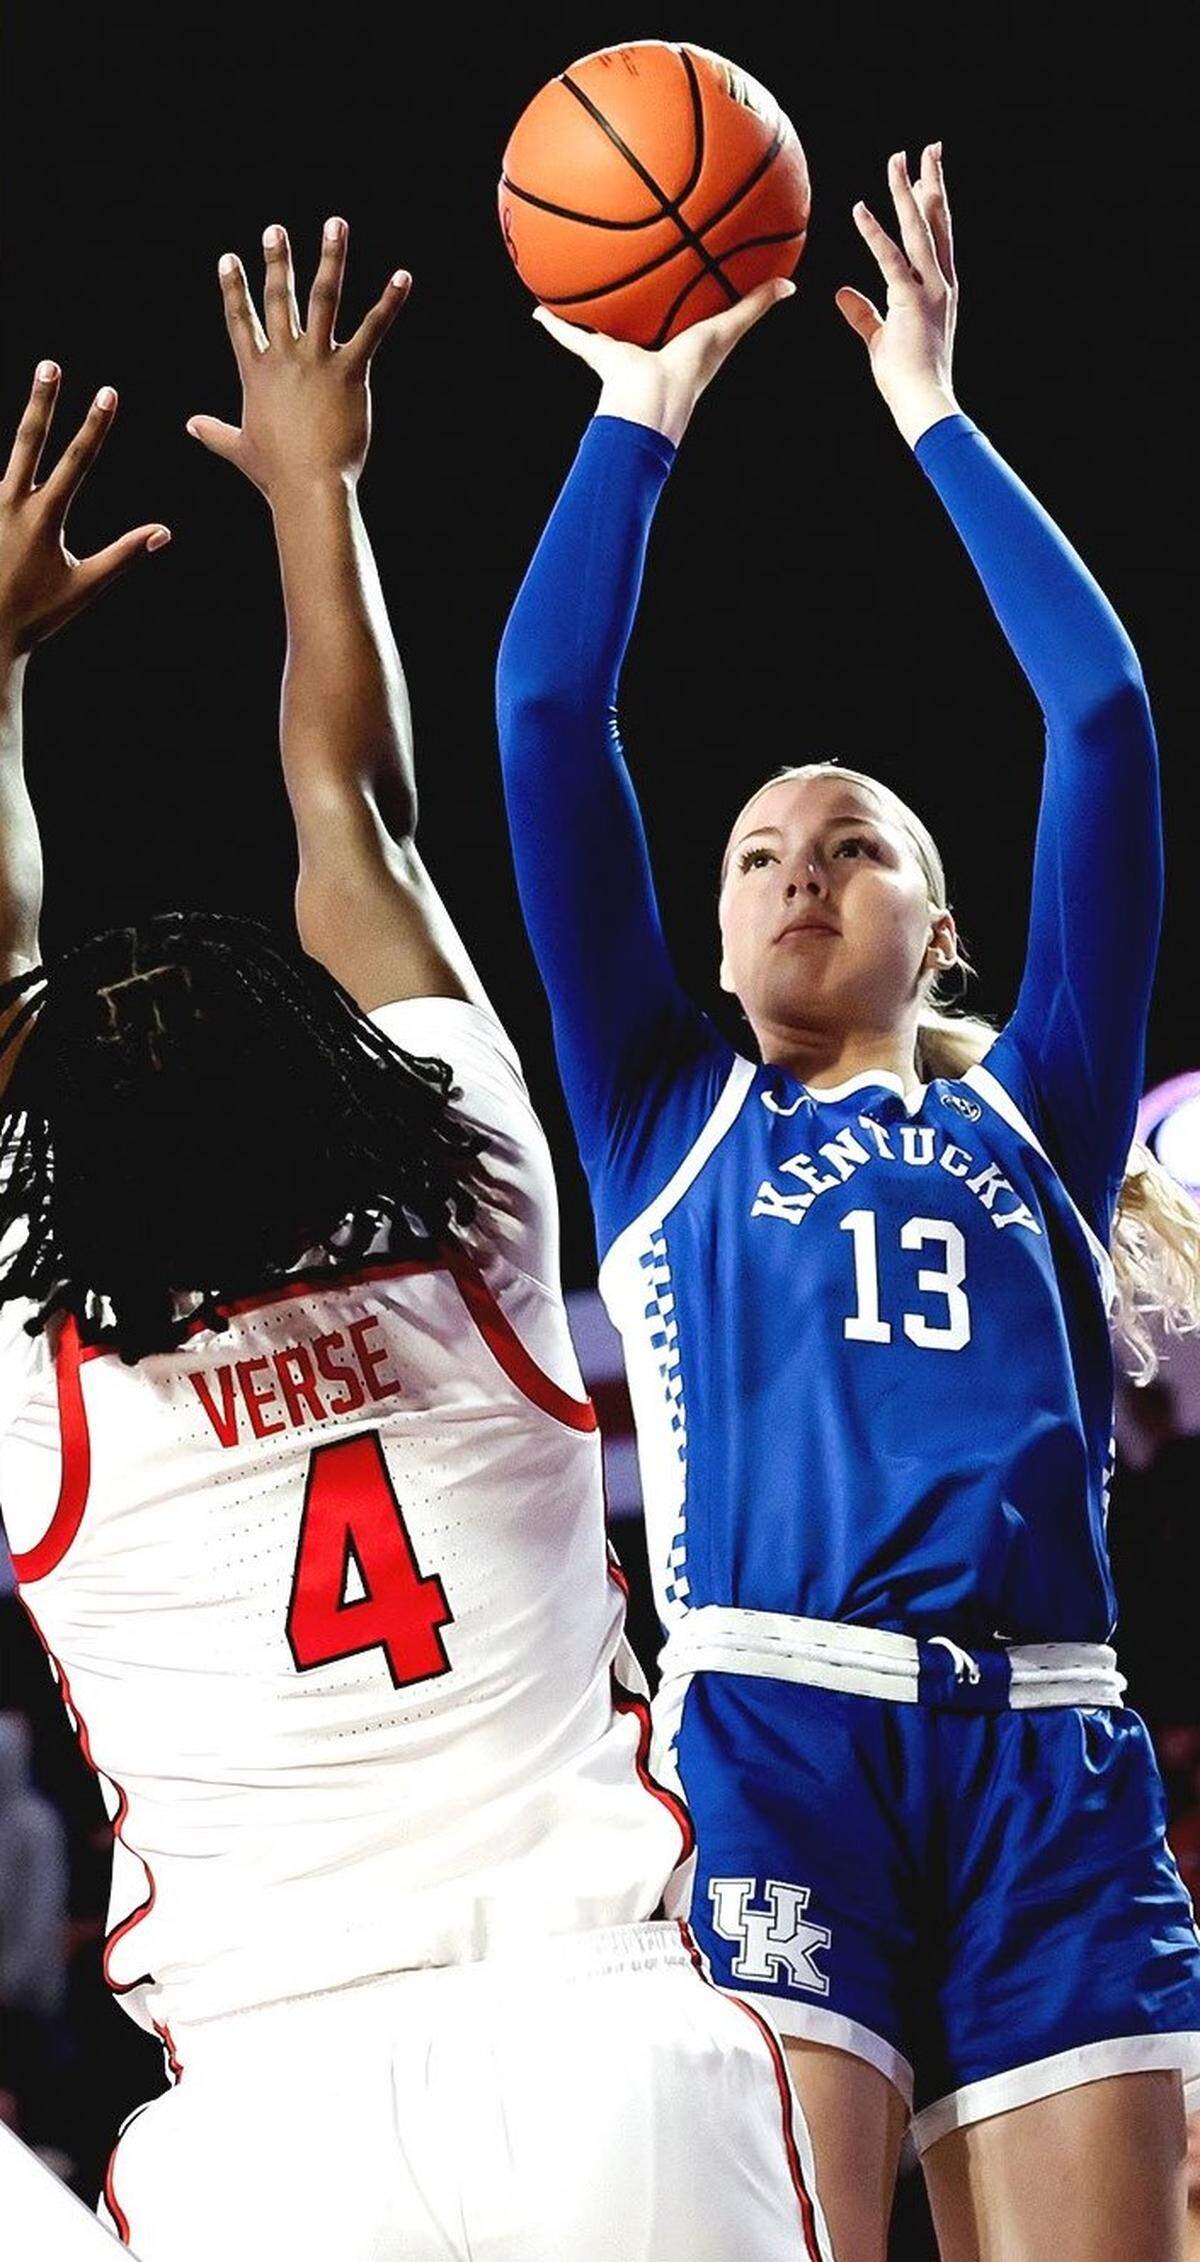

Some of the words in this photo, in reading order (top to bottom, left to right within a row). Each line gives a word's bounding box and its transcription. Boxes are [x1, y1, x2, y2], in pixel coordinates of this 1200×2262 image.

[750, 1115, 1043, 1235] KENTUCKY
[840, 1209, 971, 1351] 13
[189, 1315, 402, 1449] VERSE
[284, 1429, 455, 1691] 4
[708, 1877, 832, 1996] UK
